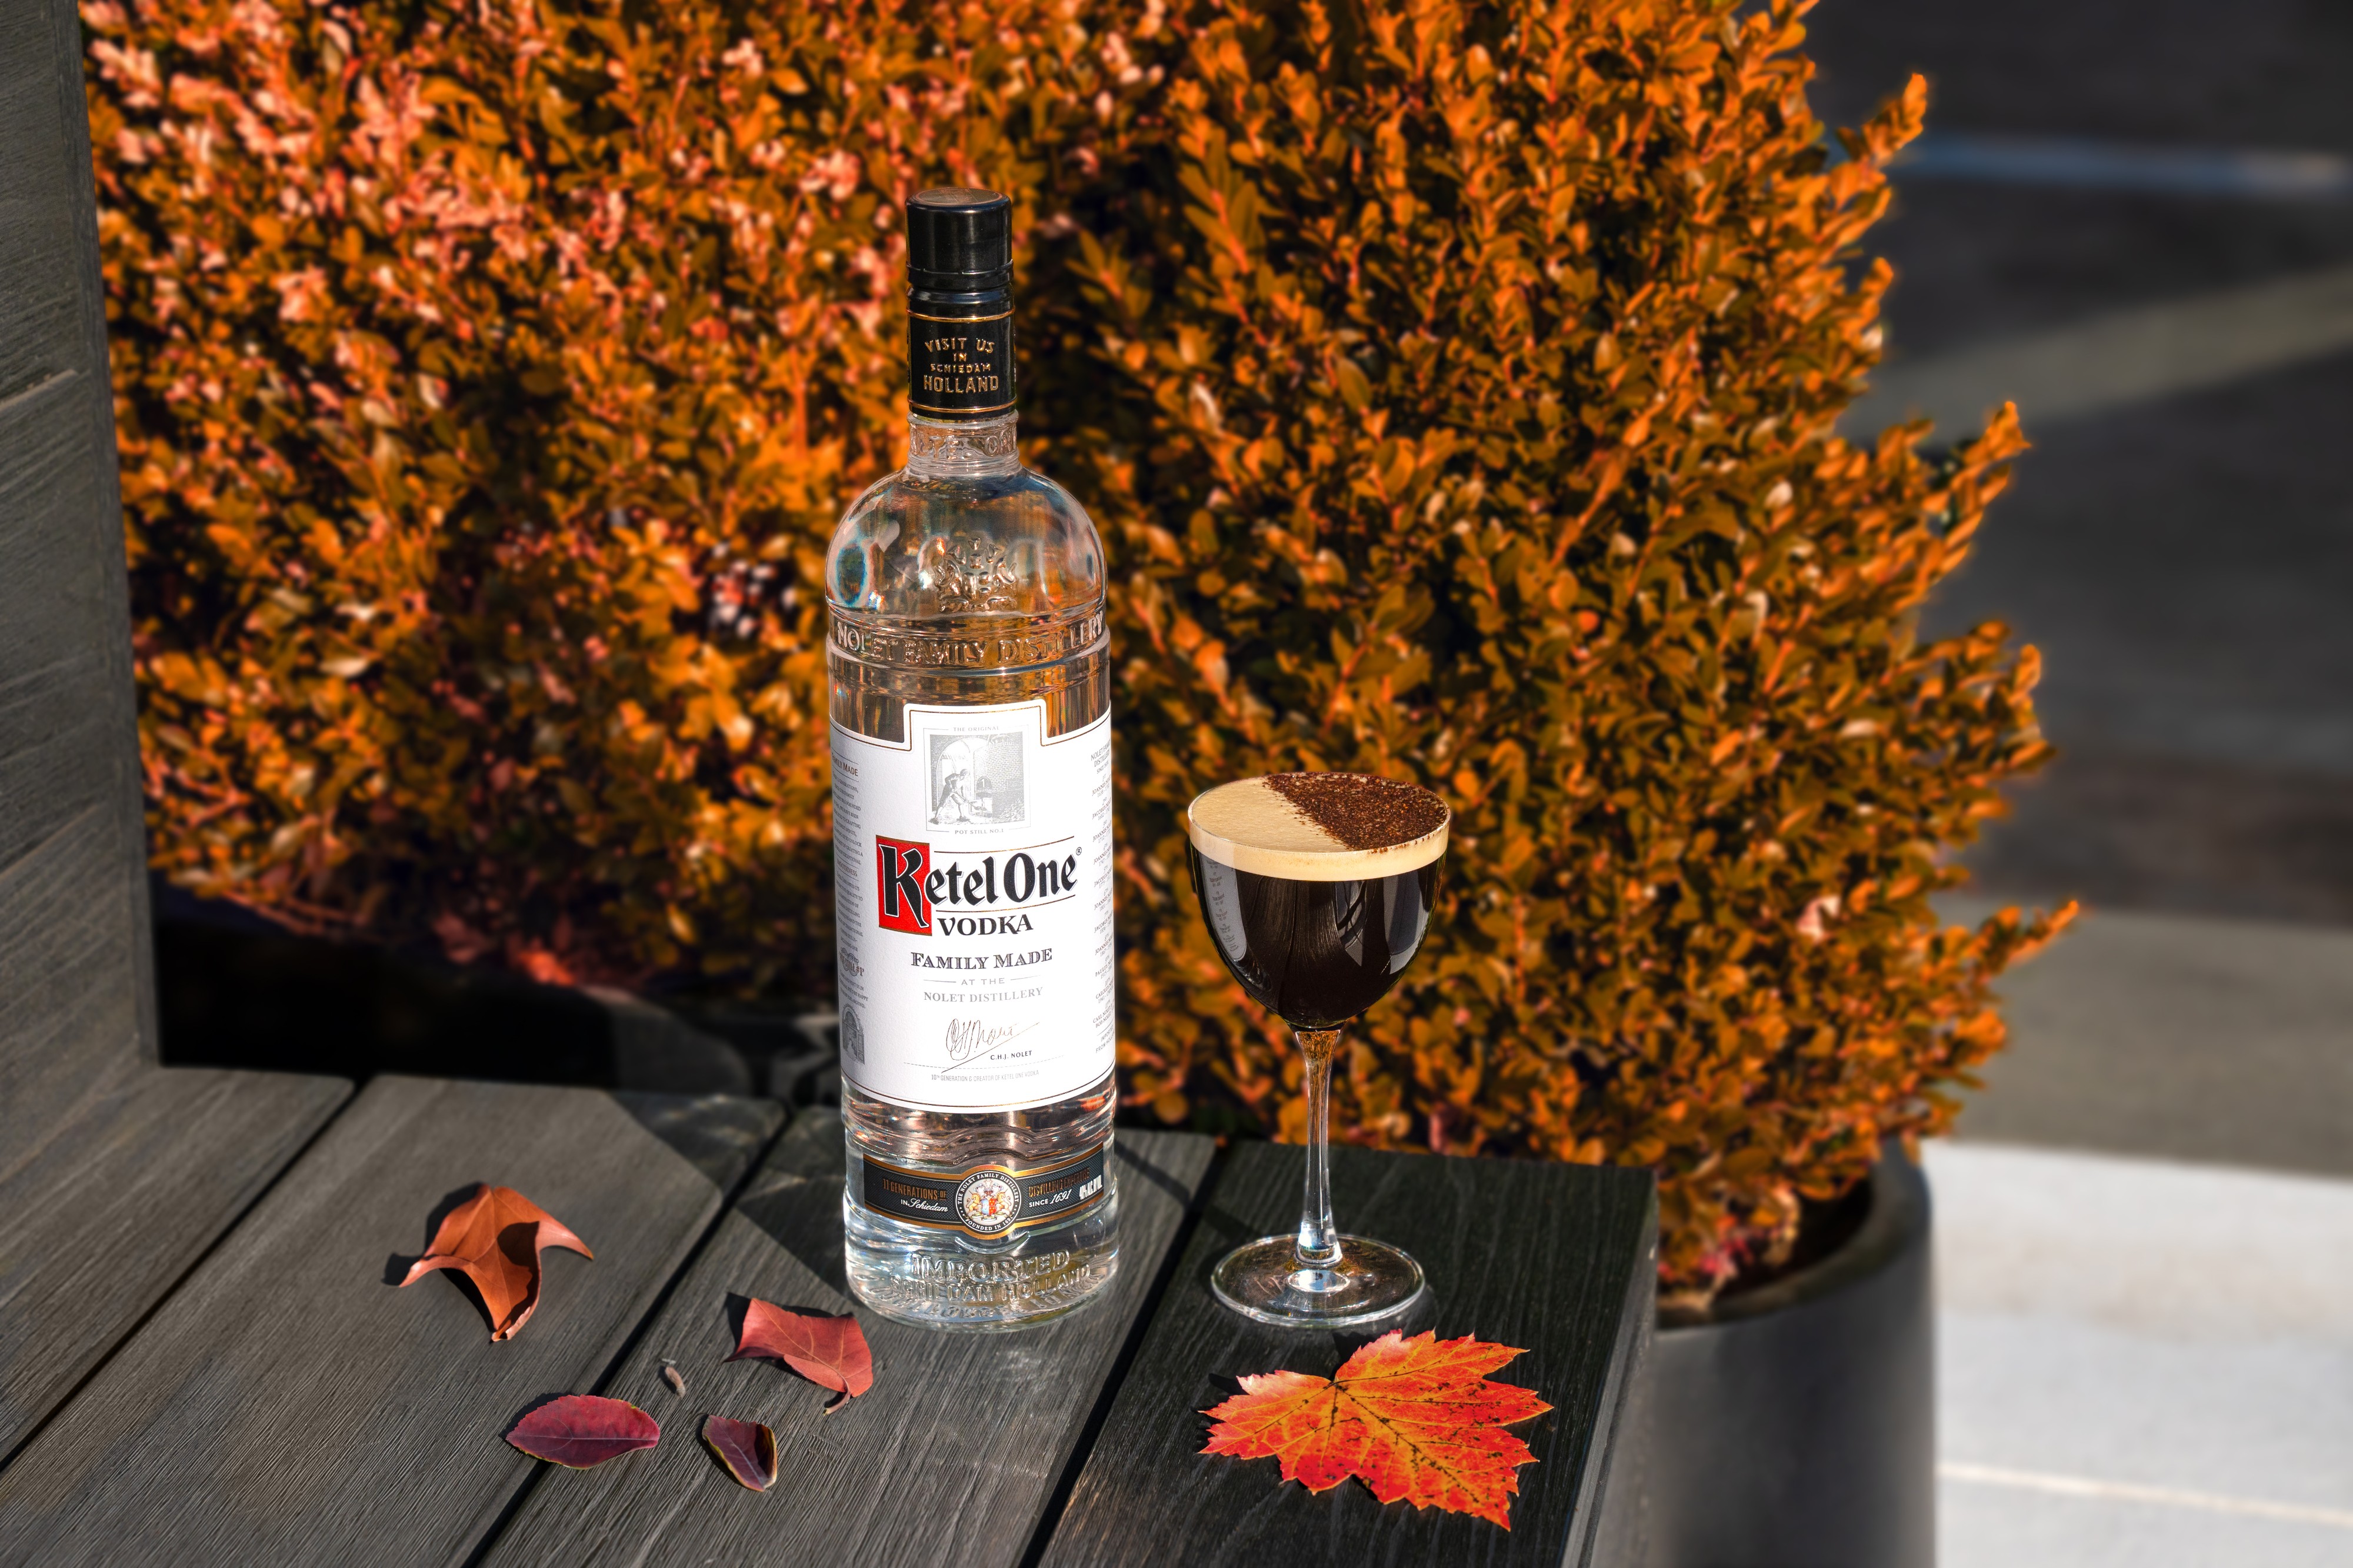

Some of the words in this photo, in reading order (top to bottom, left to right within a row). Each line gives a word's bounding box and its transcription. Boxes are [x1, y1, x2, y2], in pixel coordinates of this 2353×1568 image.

[925, 337, 968, 353] VISIT
[976, 338, 995, 353] US
[954, 353, 967, 362] IN
[930, 363, 991, 373] SCHIEDAM
[923, 375, 999, 393] HOLLAND
[843, 762, 858, 776] MADE
[982, 779, 985, 788] 1
[878, 844, 999, 929] Ketel
[937, 914, 1034, 936] VODKA
[911, 952, 989, 969] FAMILY
[993, 948, 1052, 968] MADE
[924, 991, 965, 1002] NOLET
[970, 987, 1044, 1002] DISTILLERY
[1011, 1050, 1032, 1059] NOLET
[883, 1179, 889, 1190] 11
[890, 1181, 938, 1200] GENERATIONS
[960, 1177, 975, 1192] NOLET
[999, 1174, 1019, 1202] DISTILLERY
[908, 1198, 948, 1212] Schiedam
[1029, 1199, 1048, 1207] SINCE
[1050, 1189, 1072, 1204] 1691
[965, 1219, 992, 1231] FOUNDED
[911, 1249, 1070, 1283] IMPORTED
[1001, 1263, 1091, 1302] HOLLAND
